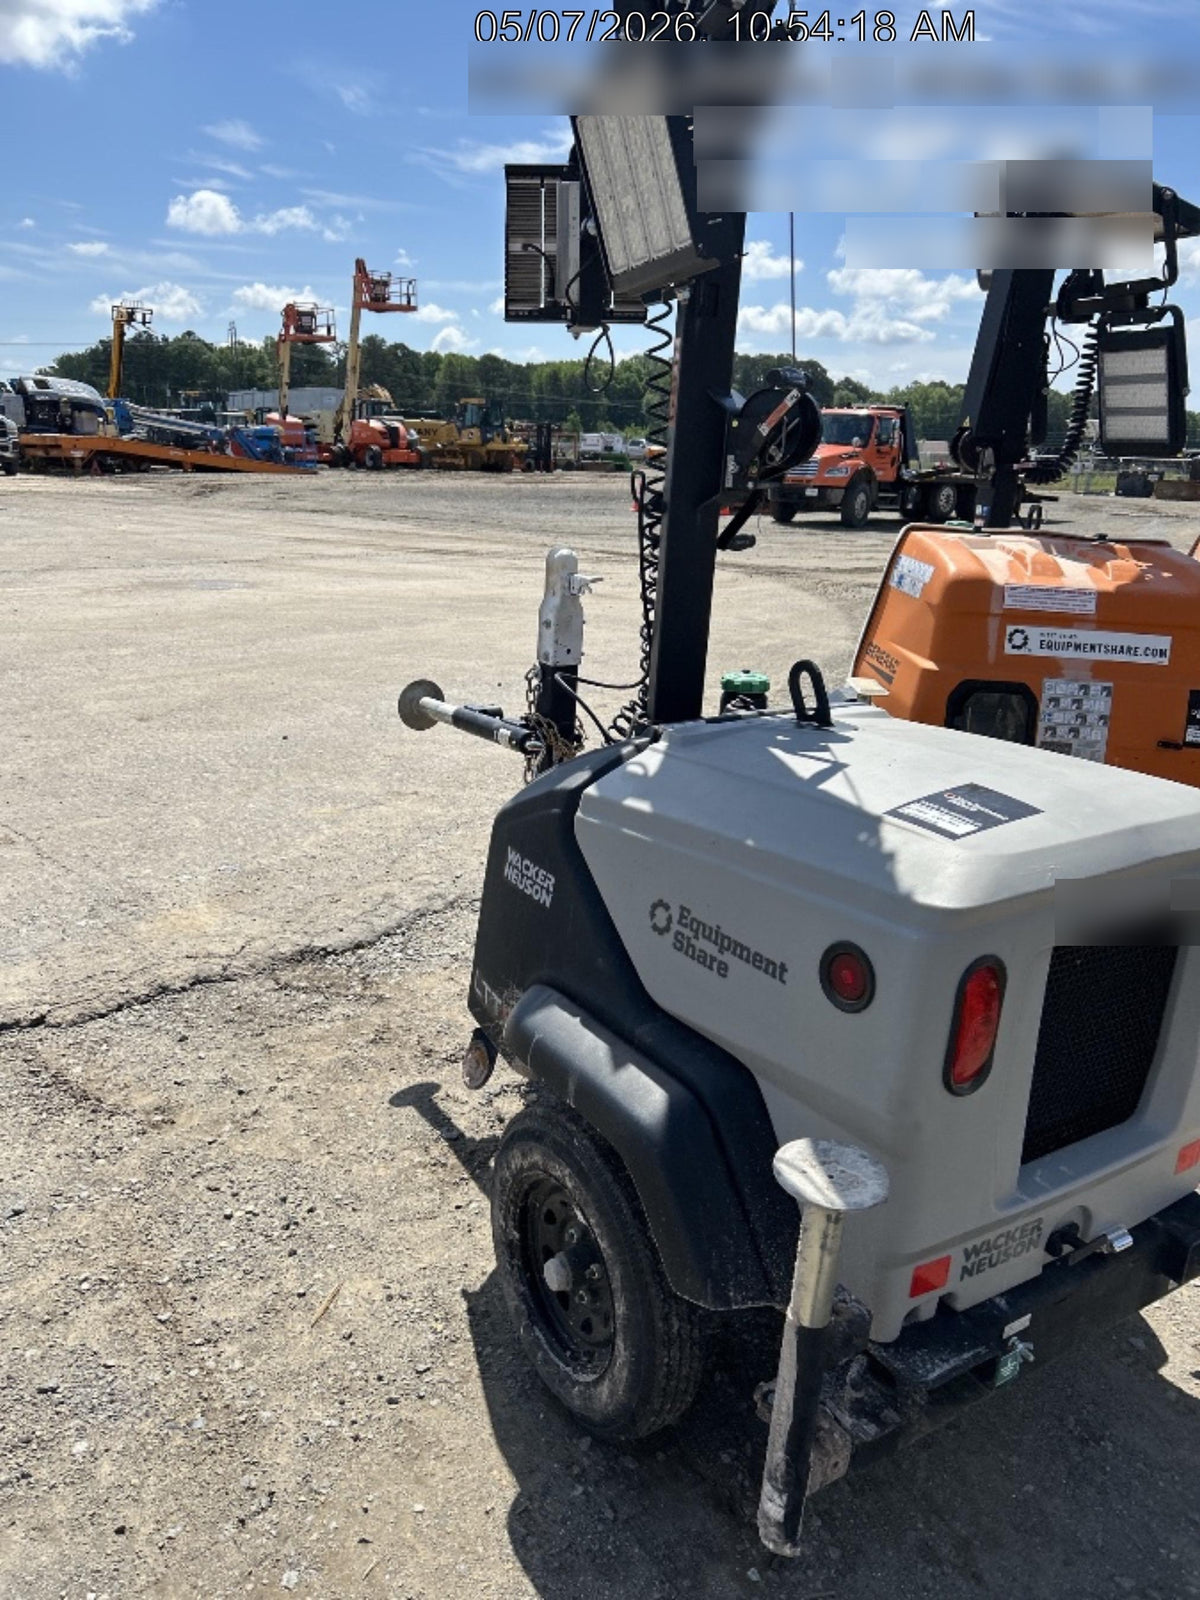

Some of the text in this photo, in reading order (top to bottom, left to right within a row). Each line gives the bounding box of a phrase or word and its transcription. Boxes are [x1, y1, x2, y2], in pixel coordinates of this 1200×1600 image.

[1039, 639, 1168, 659] EQUIPMENTSHARE.COM
[504, 864, 552, 908] NEUSON
[507, 846, 556, 892] WACKER
[672, 930, 730, 979] Share
[676, 904, 789, 985] Equipment
[959, 1233, 1042, 1282] NEUSON
[962, 1217, 1044, 1263] WACKER
